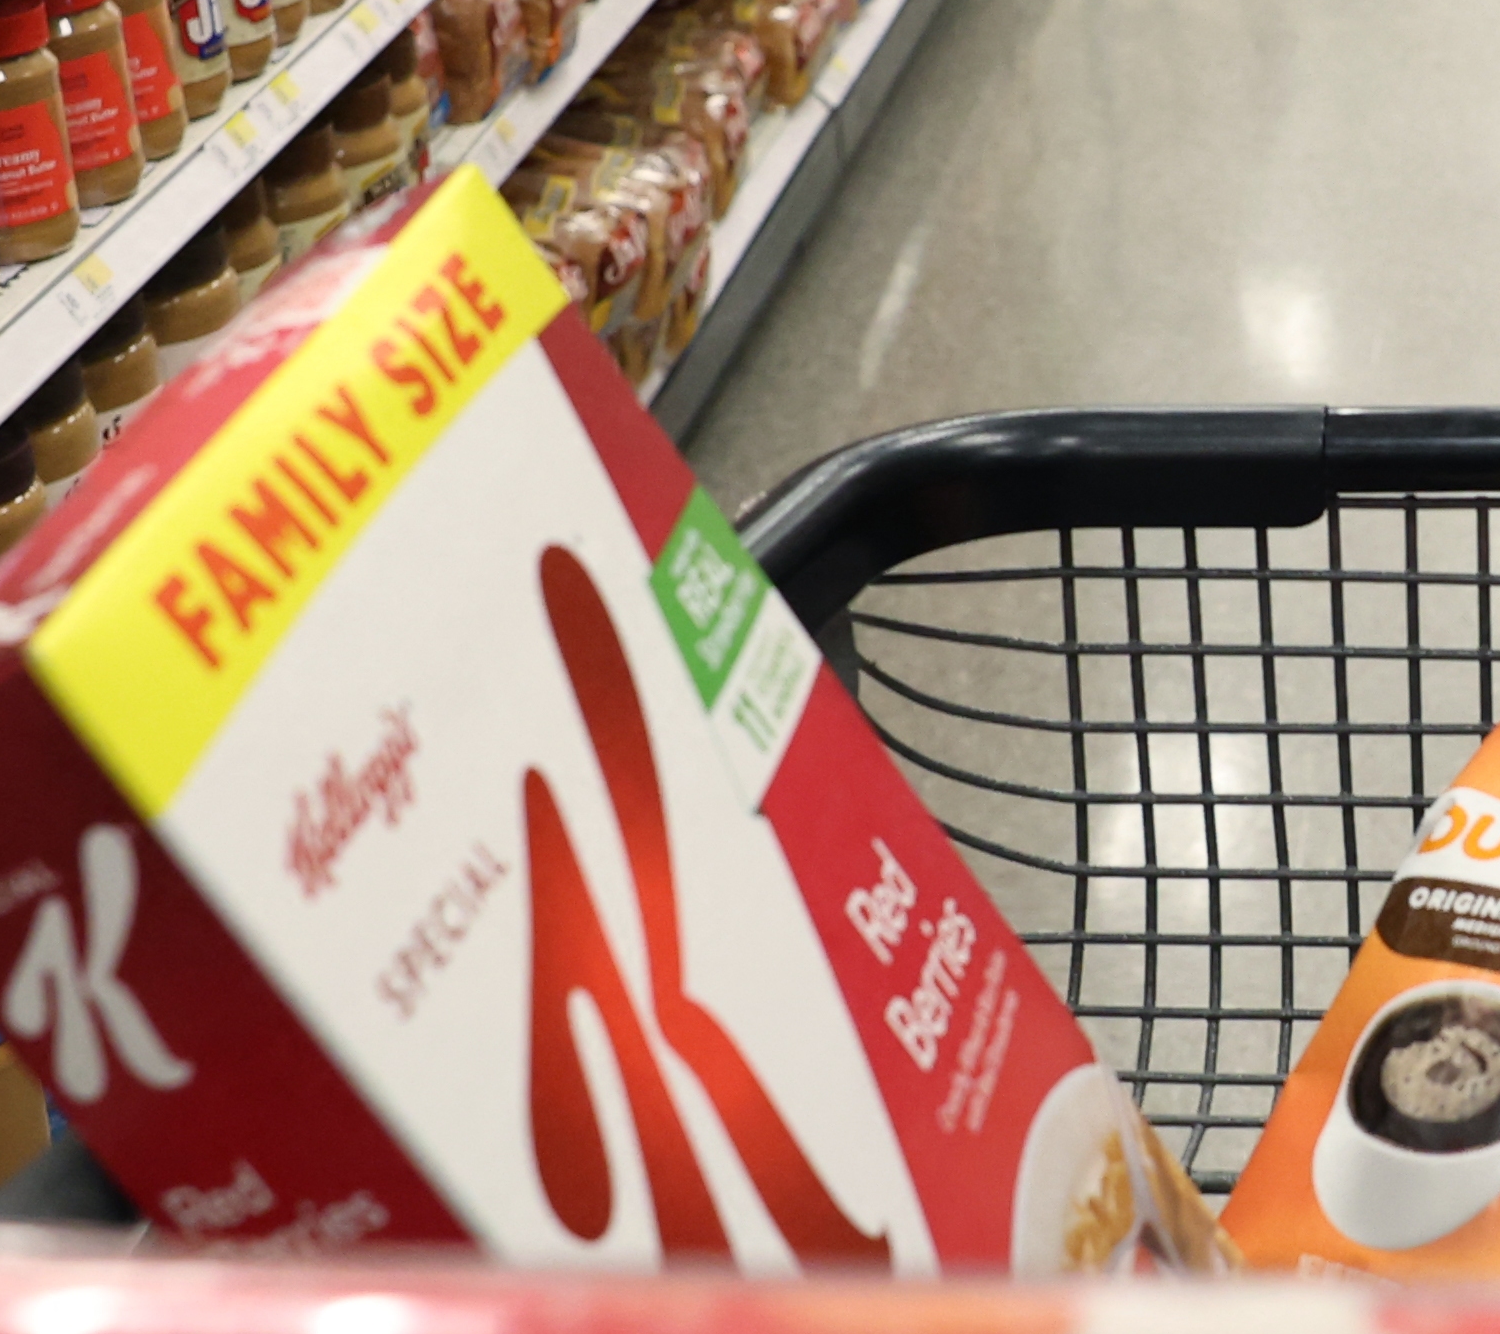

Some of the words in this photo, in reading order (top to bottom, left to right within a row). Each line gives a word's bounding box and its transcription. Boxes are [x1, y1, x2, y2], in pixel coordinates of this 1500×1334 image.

[149, 381, 394, 674] FAMILY
[365, 251, 507, 419] SIZE
[376, 841, 505, 1021] SPECIAL
[845, 837, 923, 965] Red
[883, 895, 980, 1072] Berries
